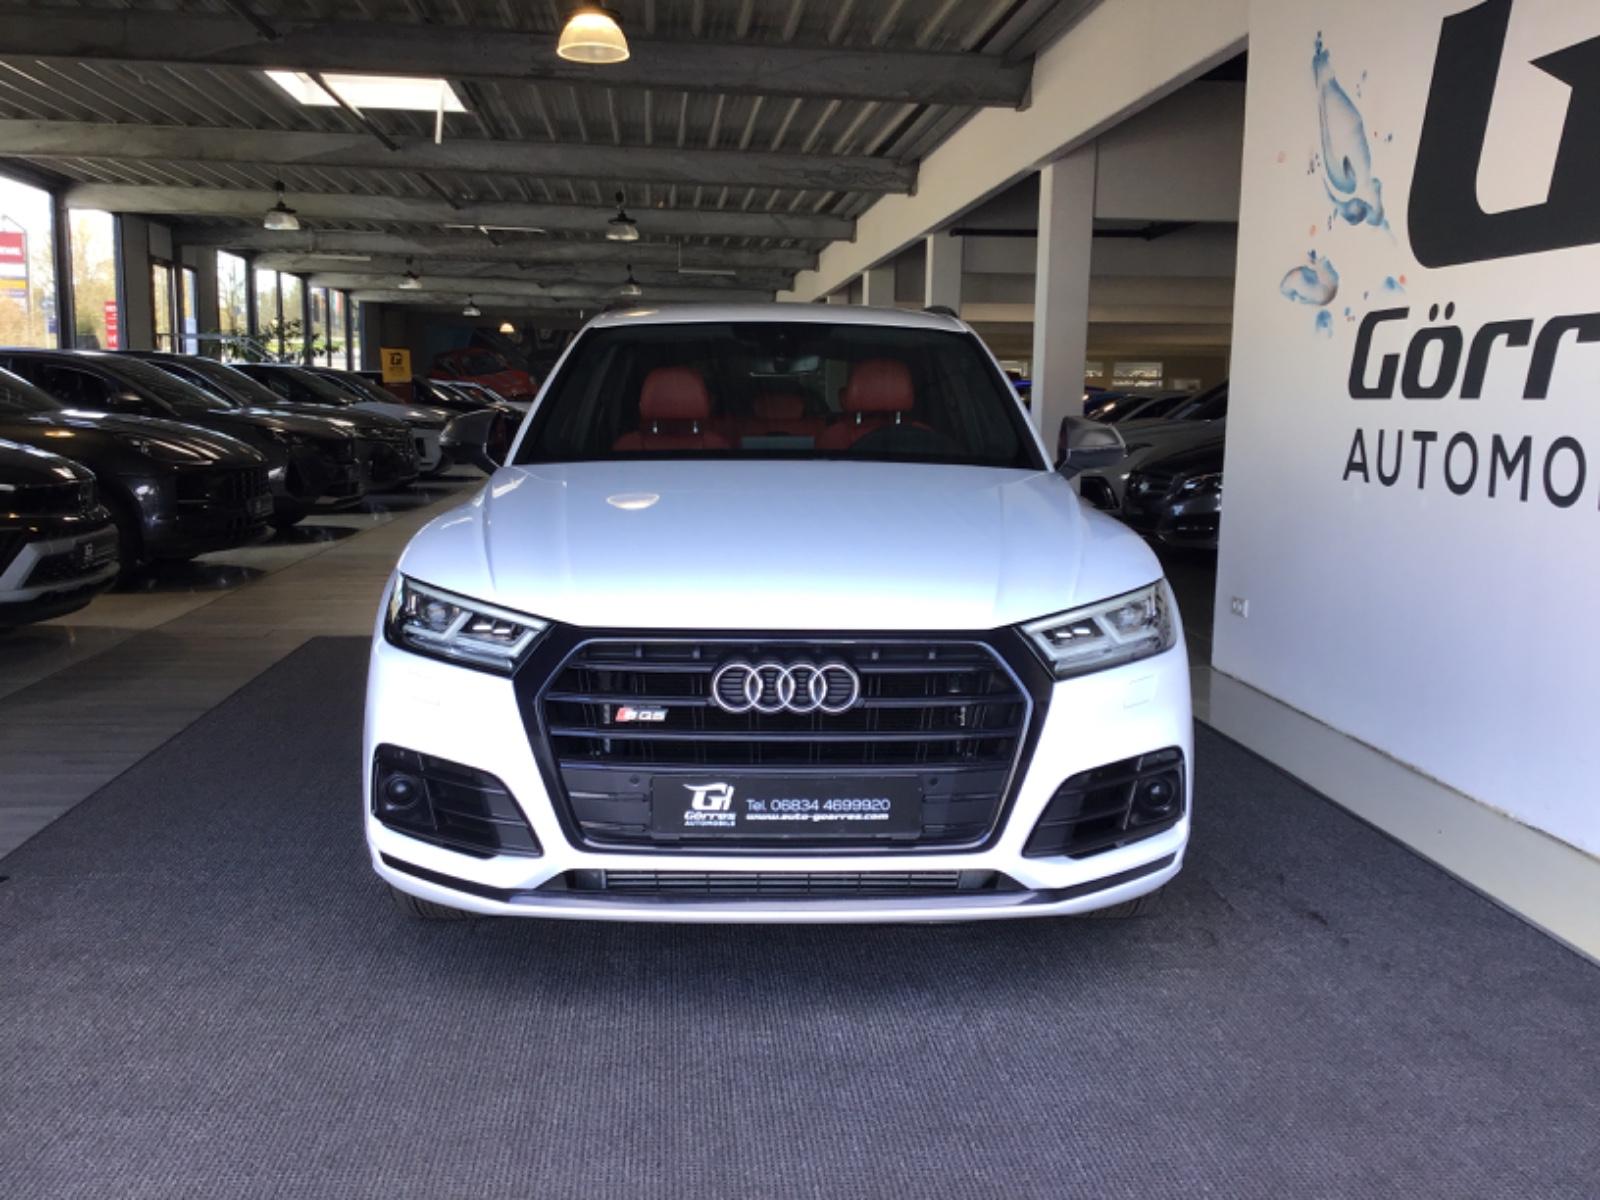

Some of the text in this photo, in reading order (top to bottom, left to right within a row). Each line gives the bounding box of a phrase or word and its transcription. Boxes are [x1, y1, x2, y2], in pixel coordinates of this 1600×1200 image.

[1343, 428, 1600, 508] AUTOMO
[770, 799, 819, 811] 06834
[823, 799, 891, 811] 4699920
